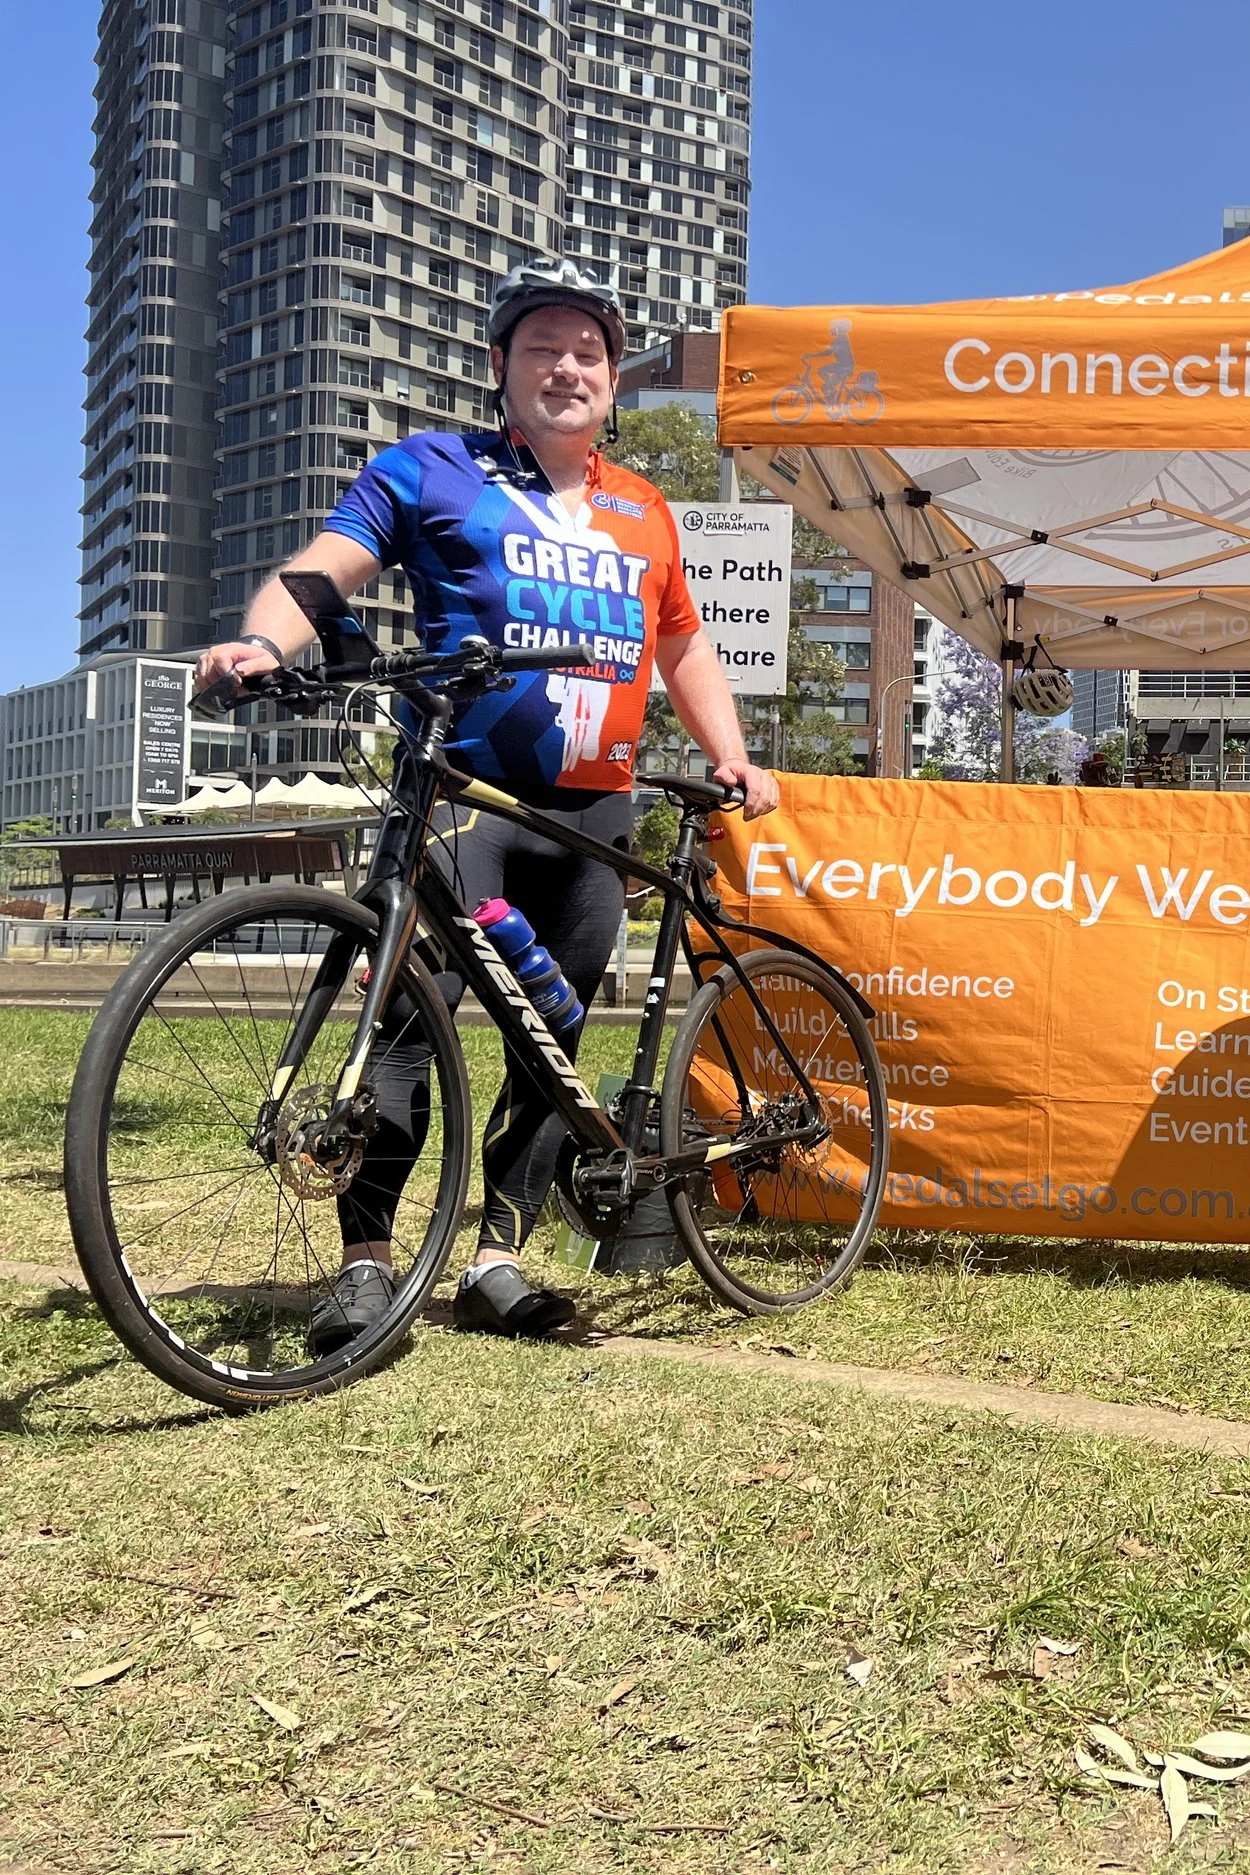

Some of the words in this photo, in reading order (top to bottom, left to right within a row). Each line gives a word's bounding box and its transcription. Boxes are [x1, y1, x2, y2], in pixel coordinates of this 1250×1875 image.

[705, 521, 770, 532] PARRAMATTA
[706, 512, 728, 522] CITY
[731, 513, 744, 522] OF
[503, 533, 649, 596] GREAT
[682, 557, 713, 580] he
[722, 558, 784, 582] Path
[506, 578, 644, 639] CYCLE
[701, 600, 770, 624] there
[716, 643, 776, 666] hare
[144, 680, 183, 690] GEORGE
[607, 742, 633, 762] 2023
[131, 852, 203, 869] PARRAMATTA
[205, 851, 234, 868] QUAY
[746, 841, 1119, 928] Everybody
[1158, 980, 1206, 1010] On
[452, 916, 600, 1109] MERIDA
[753, 1007, 826, 1036] Build
